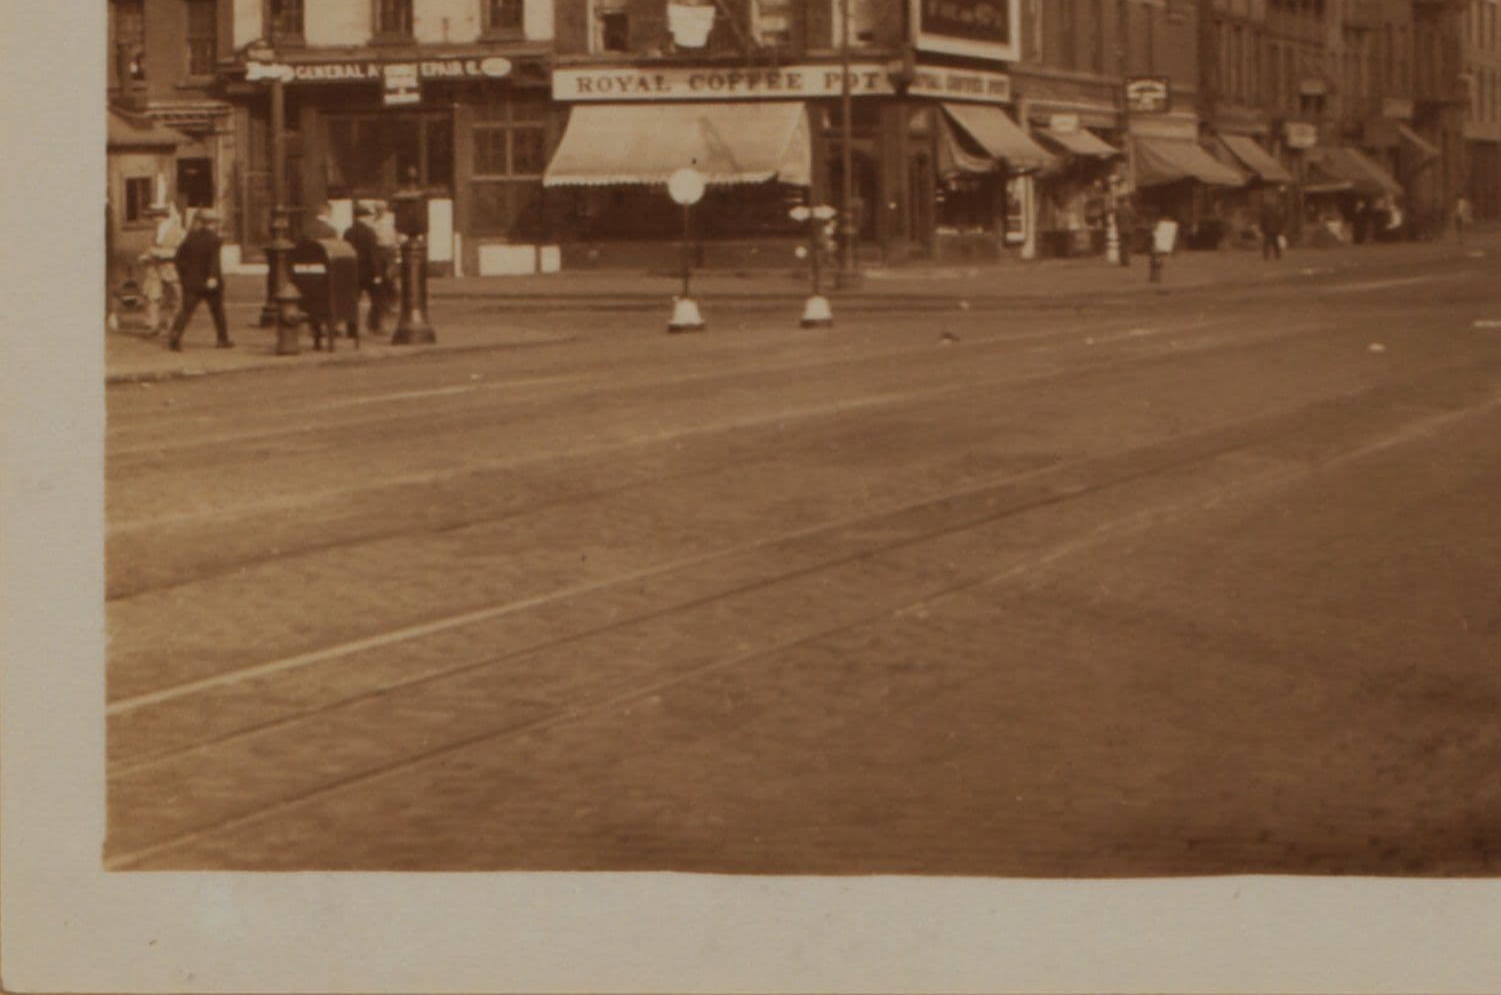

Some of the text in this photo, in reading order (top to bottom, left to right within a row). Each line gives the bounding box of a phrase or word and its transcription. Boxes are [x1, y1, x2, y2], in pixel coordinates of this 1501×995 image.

[296, 63, 365, 80] GENERAL
[421, 60, 463, 77] EPAIR
[576, 74, 671, 93] ROYAL
[688, 71, 802, 91] COFFEE
